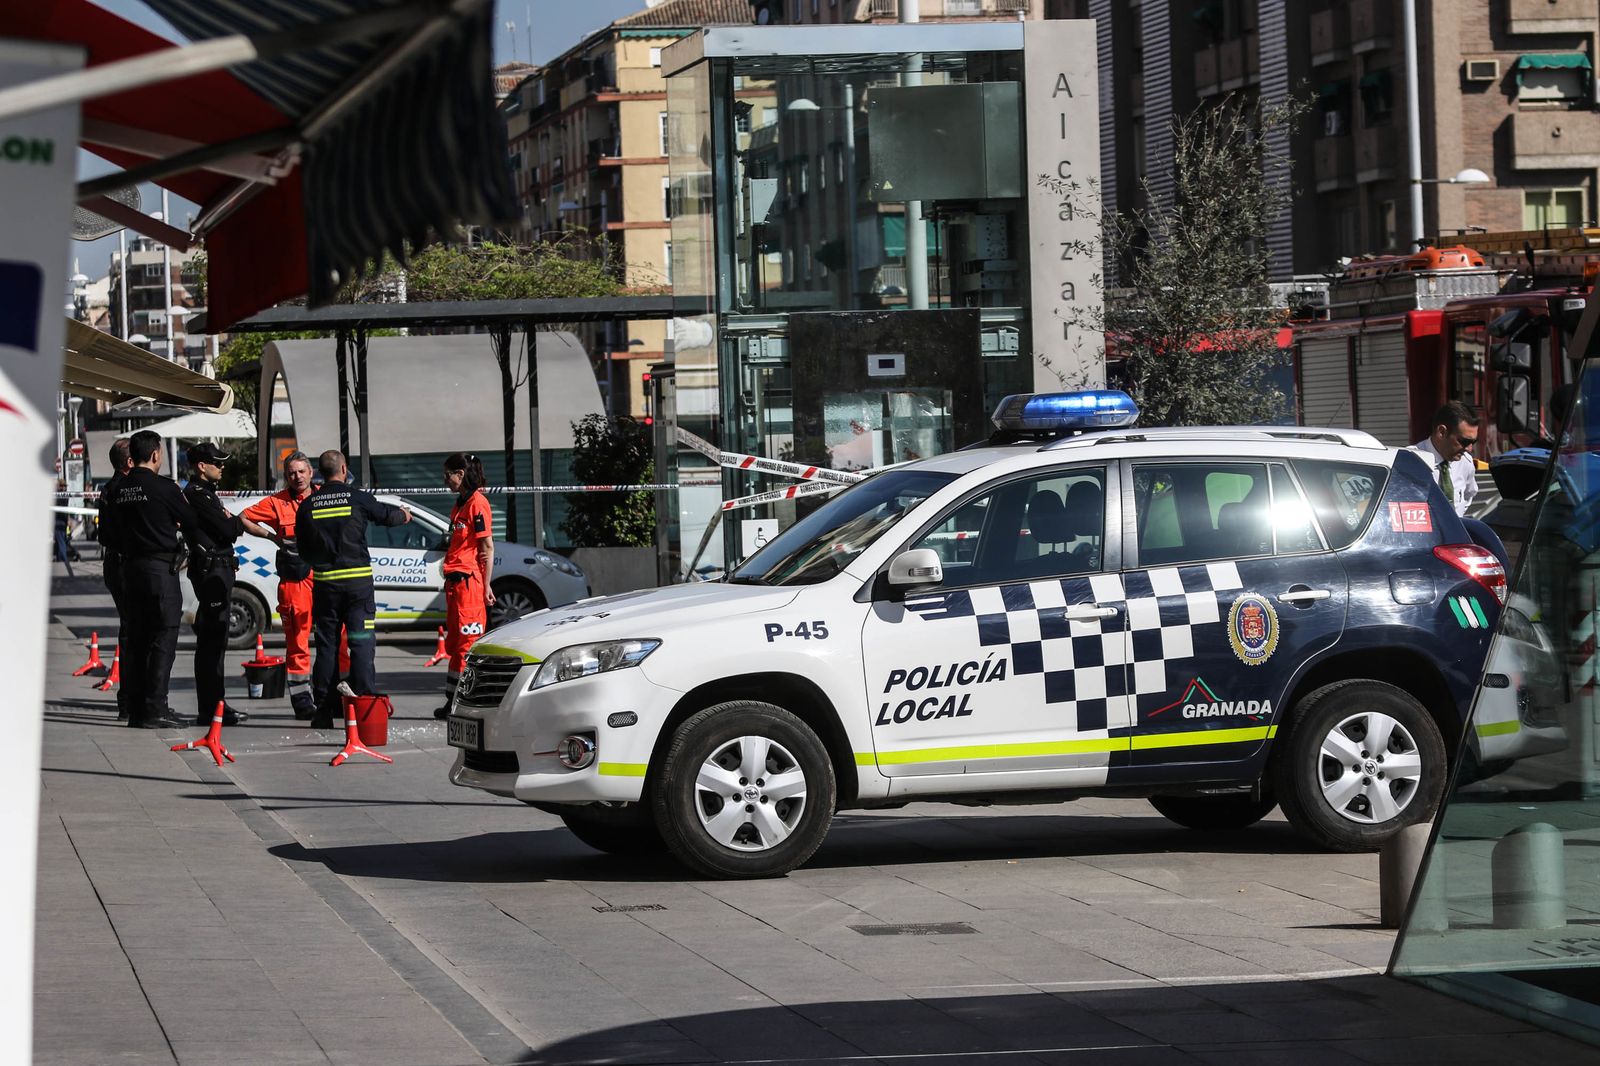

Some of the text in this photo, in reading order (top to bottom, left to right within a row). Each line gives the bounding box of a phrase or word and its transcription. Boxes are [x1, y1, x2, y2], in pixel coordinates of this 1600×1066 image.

[0, 136, 54, 167] ON
[1052, 73, 1075, 340] Alcázar
[757, 460, 776, 472] BOMBEROS
[782, 463, 799, 475] GRANADA
[311, 492, 351, 502] BOMBEROS
[313, 498, 348, 508] GRANADA
[1405, 509, 1426, 520] 112
[370, 557, 427, 567] POLICIA
[374, 575, 427, 583] GRANADA
[461, 621, 484, 635] 061
[764, 620, 829, 643] P-45
[883, 652, 1008, 694] POLICÍA
[874, 693, 973, 726] LOCAL
[1182, 699, 1272, 719] GRANADA
